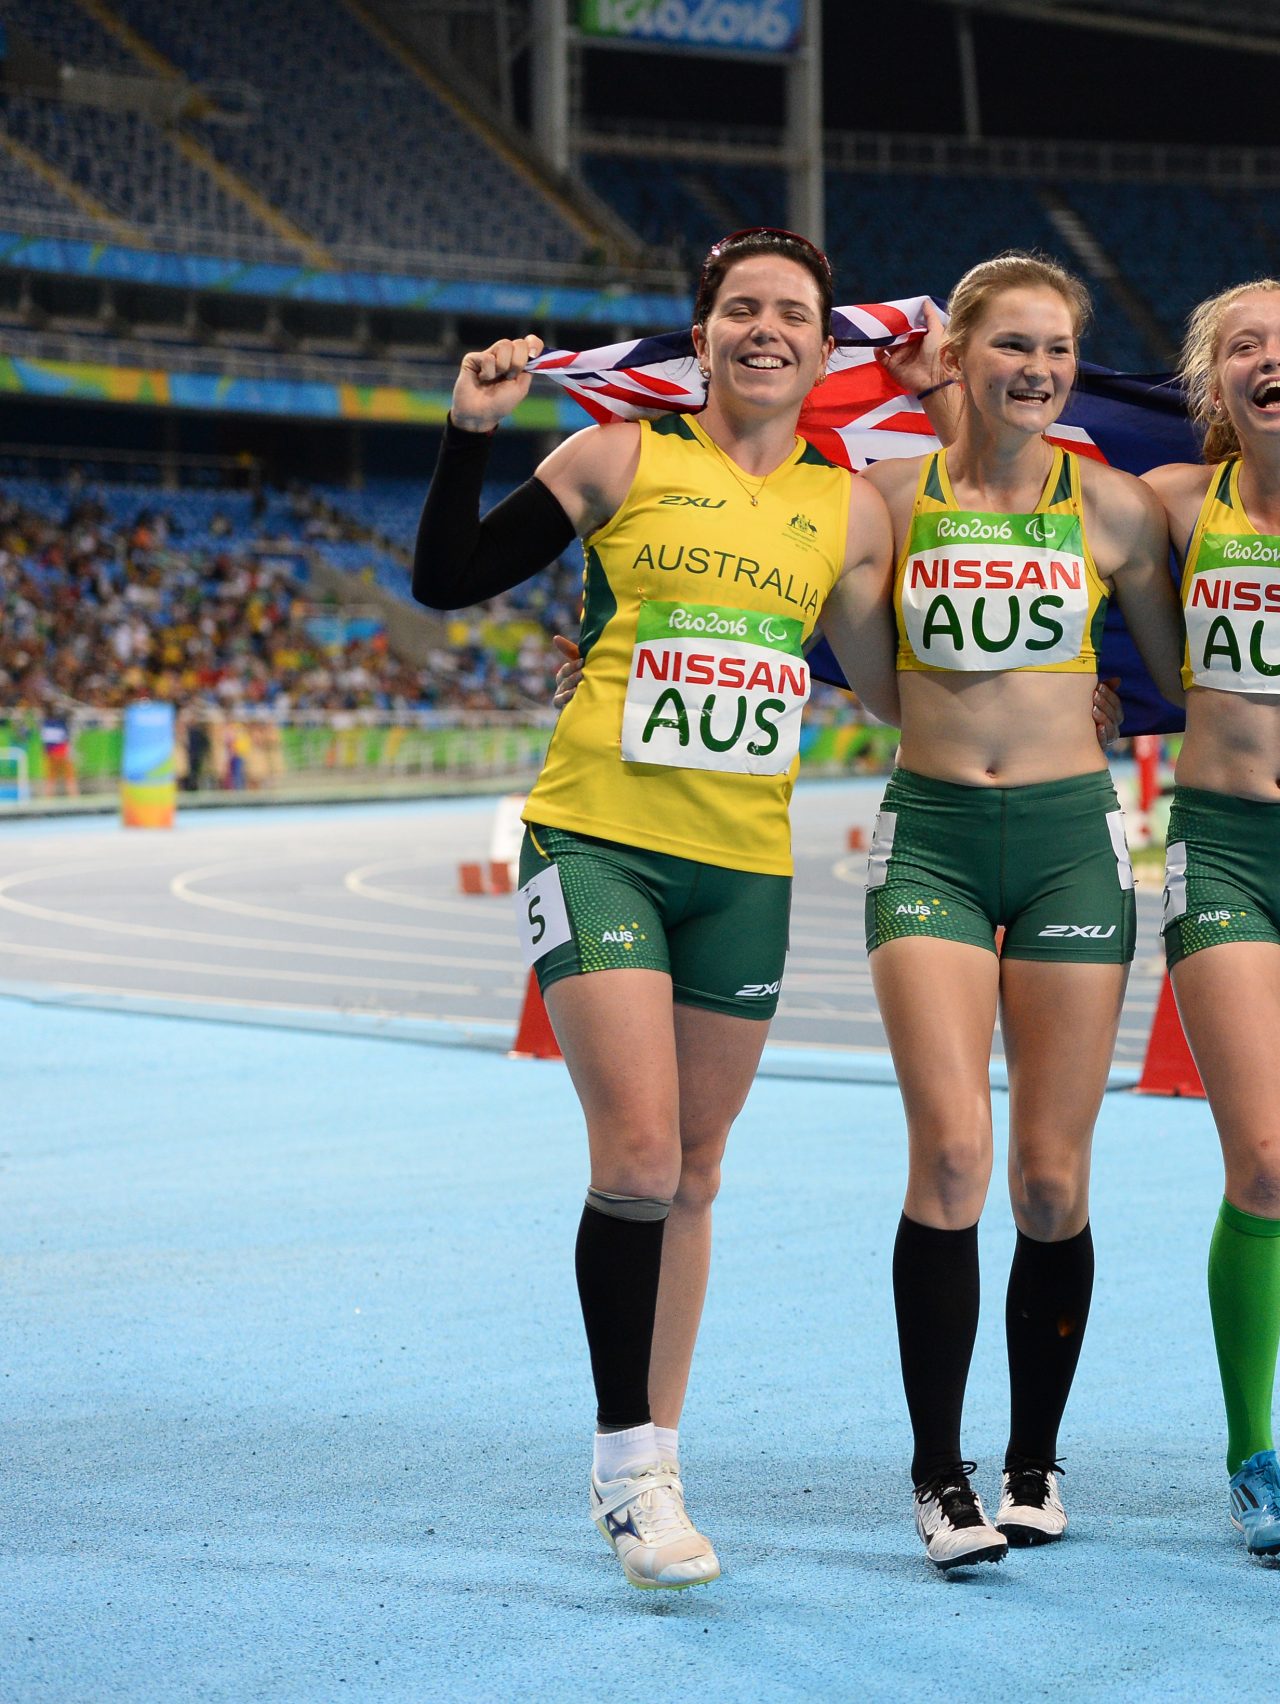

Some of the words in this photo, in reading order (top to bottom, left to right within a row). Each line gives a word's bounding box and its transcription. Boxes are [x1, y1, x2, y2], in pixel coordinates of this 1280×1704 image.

[658, 495, 727, 509] 2XU
[937, 517, 1013, 540] Rio2016
[633, 543, 820, 617] AUSTRALIA
[911, 559, 1081, 590] NISSAN
[668, 608, 748, 637] Rio2016
[922, 594, 1064, 653] AUS
[636, 648, 806, 697] NISSAN
[641, 687, 786, 756] AUS
[528, 895, 546, 945] 5
[895, 904, 931, 916] AUS
[1197, 910, 1231, 924] AUS
[602, 930, 634, 943] AUS
[1038, 925, 1117, 939] 2XU
